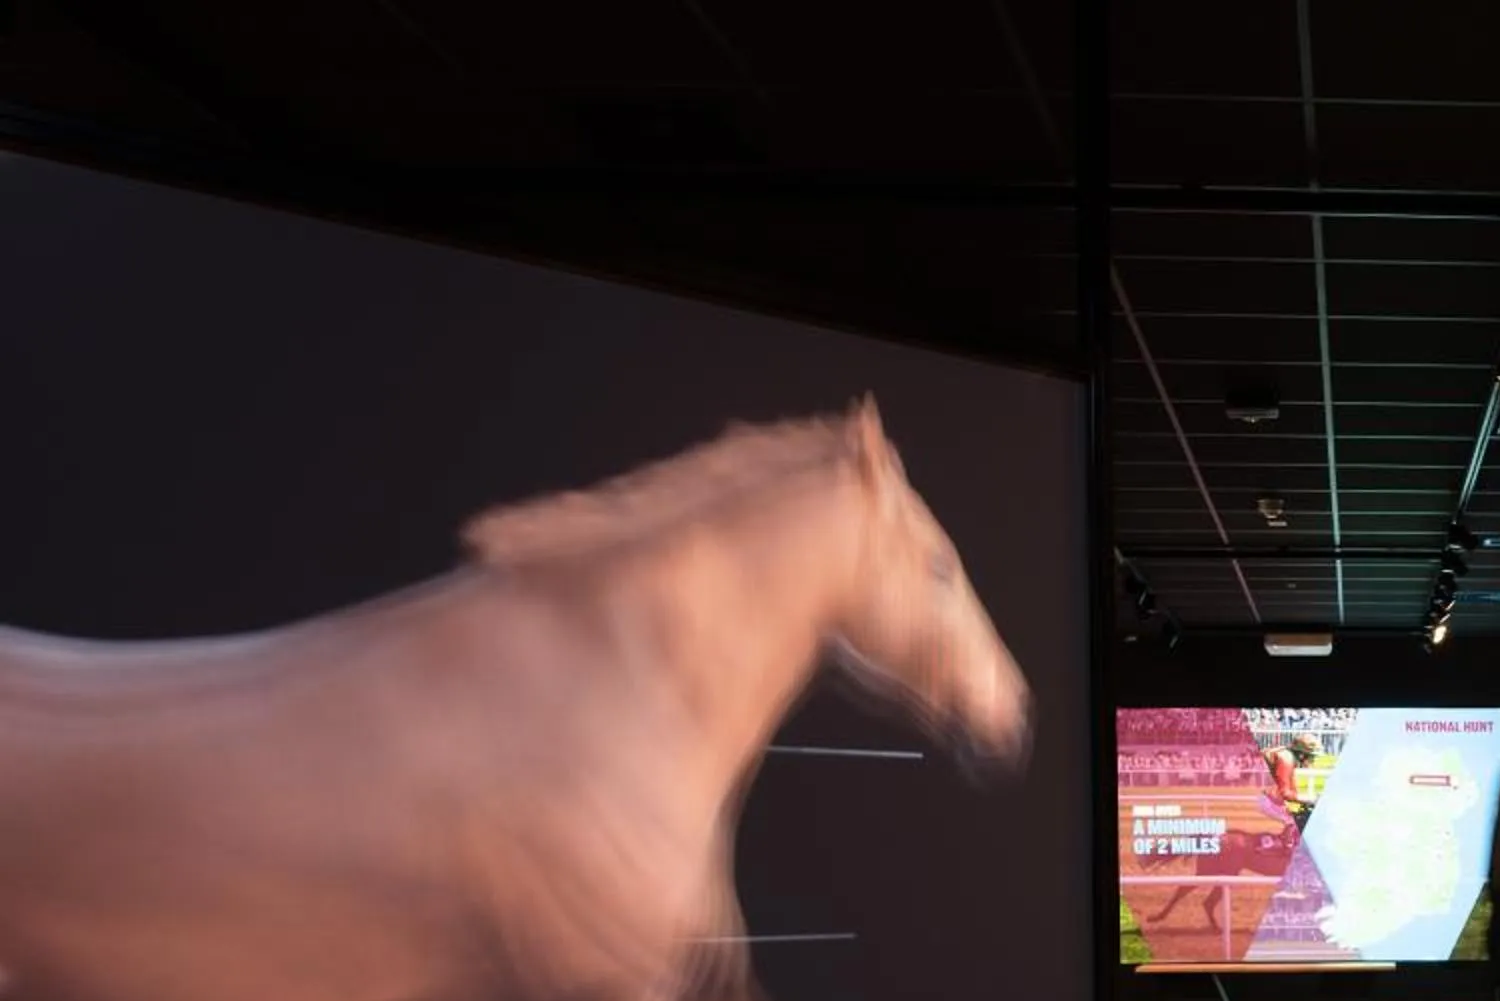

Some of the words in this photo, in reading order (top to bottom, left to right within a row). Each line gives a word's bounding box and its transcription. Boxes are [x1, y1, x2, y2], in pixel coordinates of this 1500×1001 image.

[1405, 720, 1461, 733] NATIONAL
[1464, 720, 1494, 733] HUNT
[1133, 818, 1145, 836] A
[1147, 818, 1226, 836] MINIMUM
[1133, 837, 1155, 855] OF
[1157, 837, 1169, 855] 2
[1171, 837, 1221, 855] MILES
